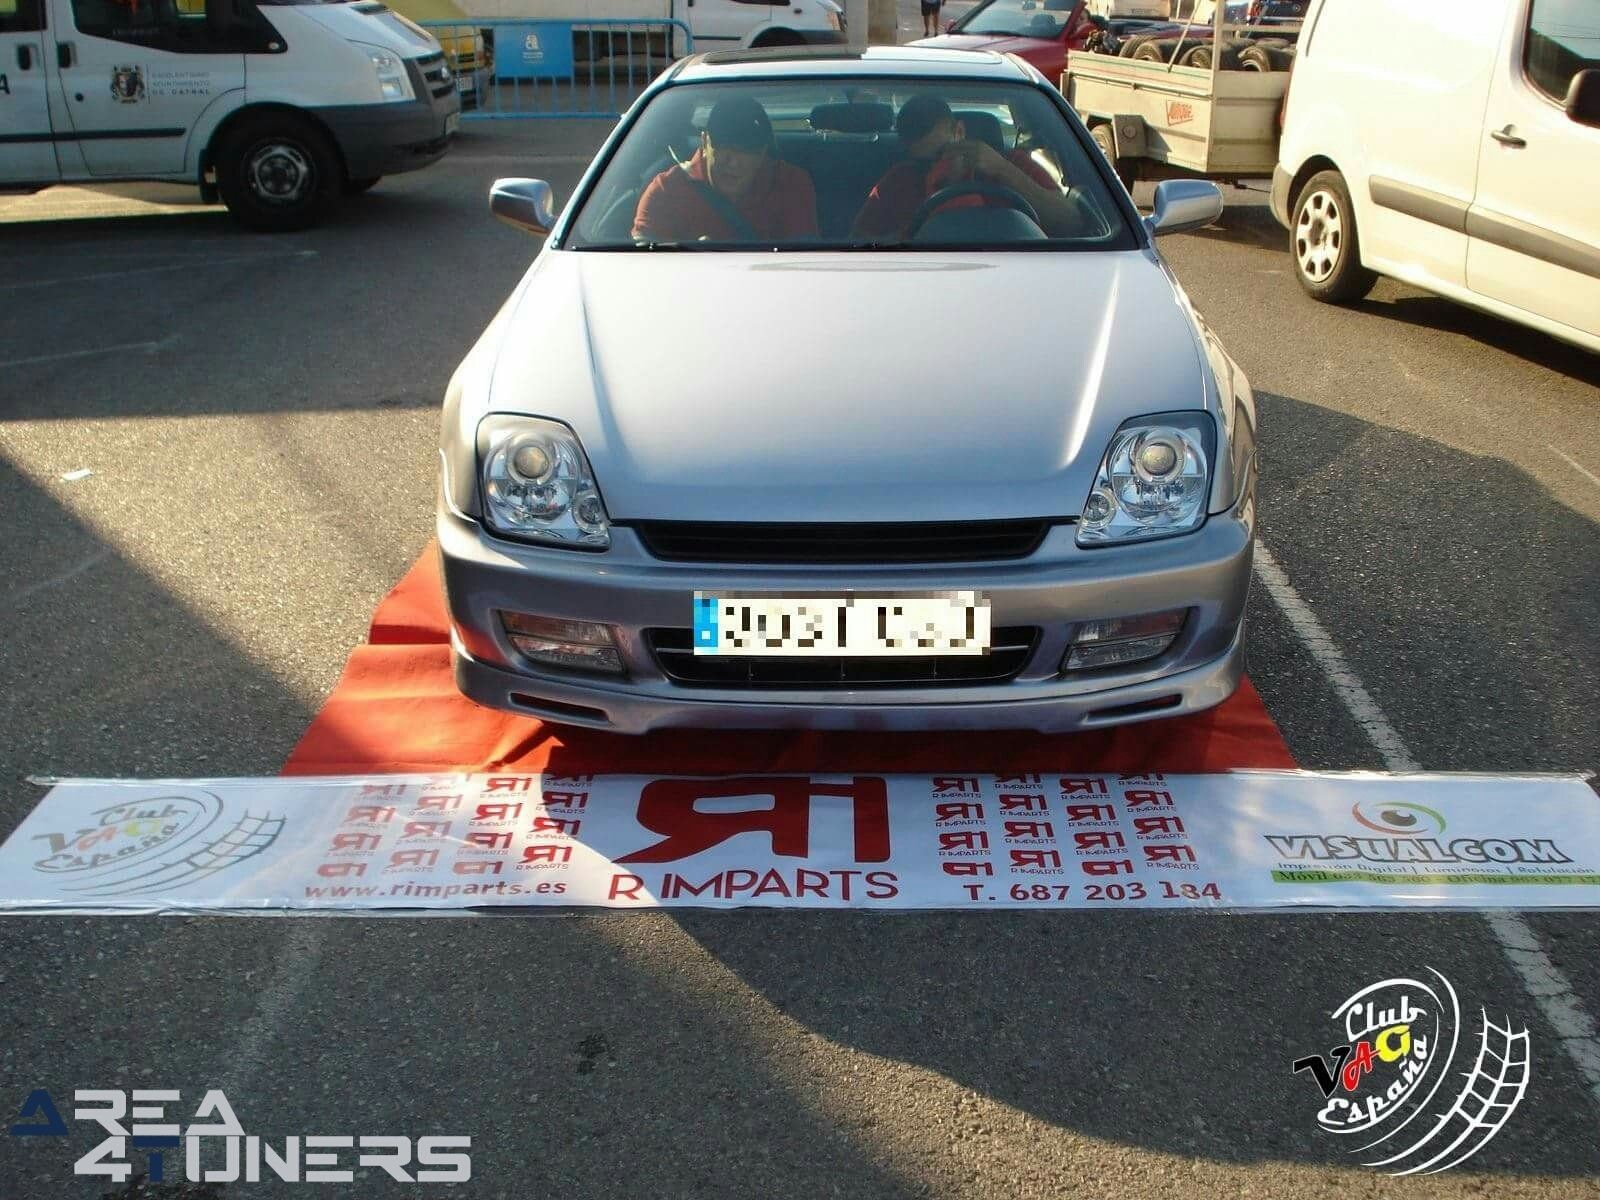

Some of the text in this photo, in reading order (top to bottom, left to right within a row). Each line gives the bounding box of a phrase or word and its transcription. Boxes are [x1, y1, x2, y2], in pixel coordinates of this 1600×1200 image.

[100, 804, 188, 826] Club
[1264, 834, 1574, 863] VISUALCOM
[305, 881, 567, 899] www.rimparts.es
[607, 868, 899, 901] R IMPARTS
[963, 881, 1222, 901] T. 687 203 184
